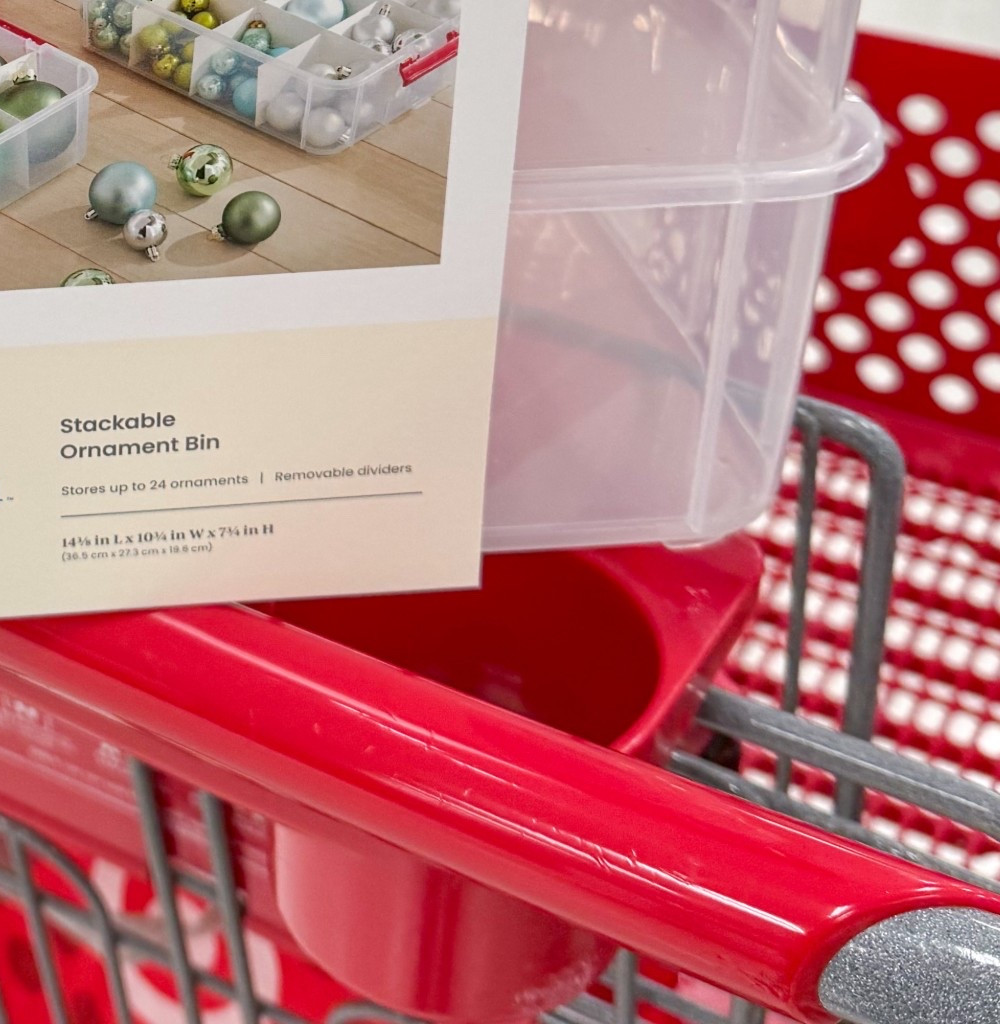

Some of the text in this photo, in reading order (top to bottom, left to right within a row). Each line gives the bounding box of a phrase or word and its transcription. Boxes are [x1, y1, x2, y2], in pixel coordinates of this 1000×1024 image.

[60, 411, 176, 433] Stackable
[60, 433, 220, 459] Ornament Bin
[61, 483, 106, 496] Stores
[109, 483, 128, 495] up
[132, 481, 146, 492] to
[149, 479, 167, 490] 24
[170, 474, 249, 489] ornaments
[274, 467, 354, 482] Removable
[357, 463, 413, 476] dividers
[94, 534, 110, 546] in
[113, 534, 123, 545] L
[170, 529, 186, 541] in
[189, 528, 204, 540] W
[243, 524, 259, 536] in
[262, 523, 274, 535] H
